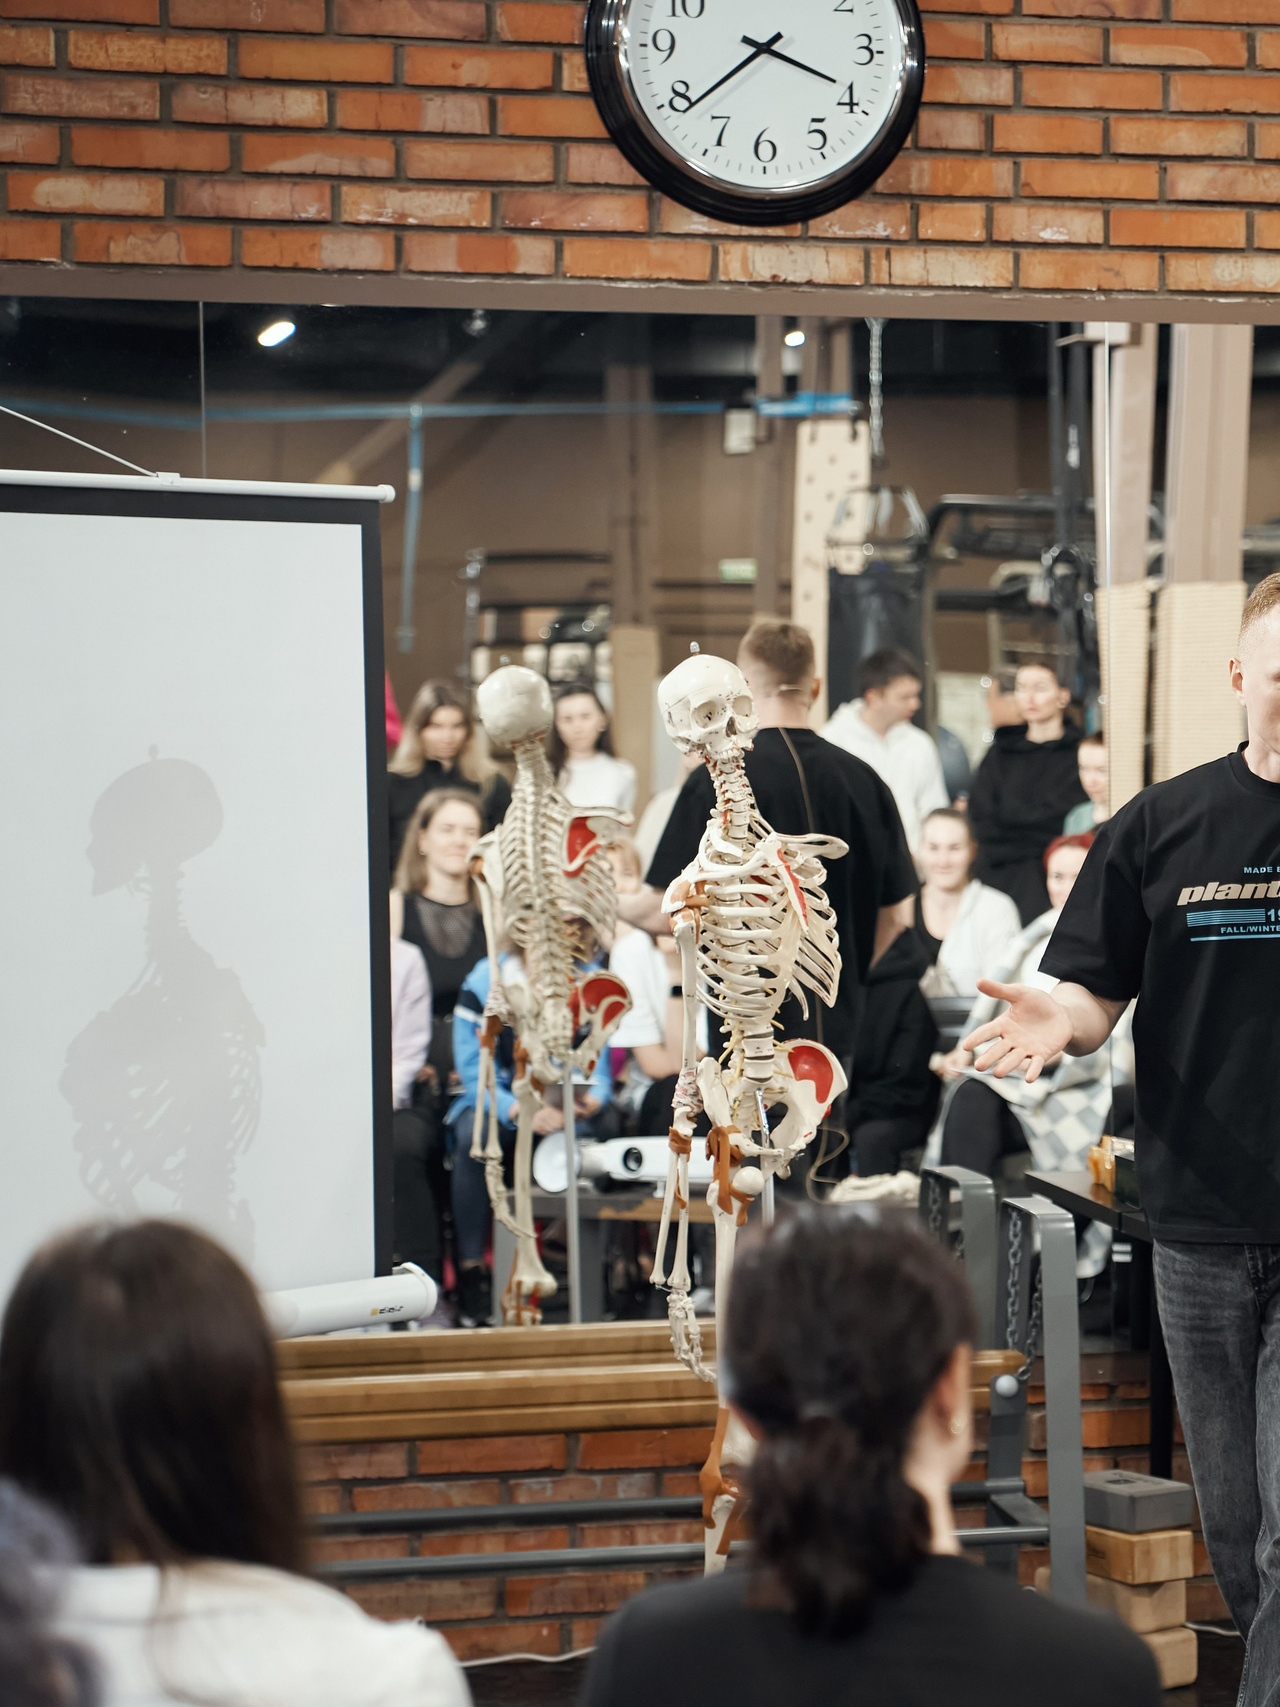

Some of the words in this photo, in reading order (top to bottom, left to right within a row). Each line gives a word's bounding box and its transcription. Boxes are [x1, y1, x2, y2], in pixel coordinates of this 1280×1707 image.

[652, 28, 676, 65] 9
[853, 33, 875, 66] 3
[668, 80, 693, 113] 8
[836, 81, 859, 114] 4
[710, 115, 731, 147] 7
[754, 127, 777, 163] 6
[807, 117, 827, 150] 5
[1243, 866, 1273, 874] MADE
